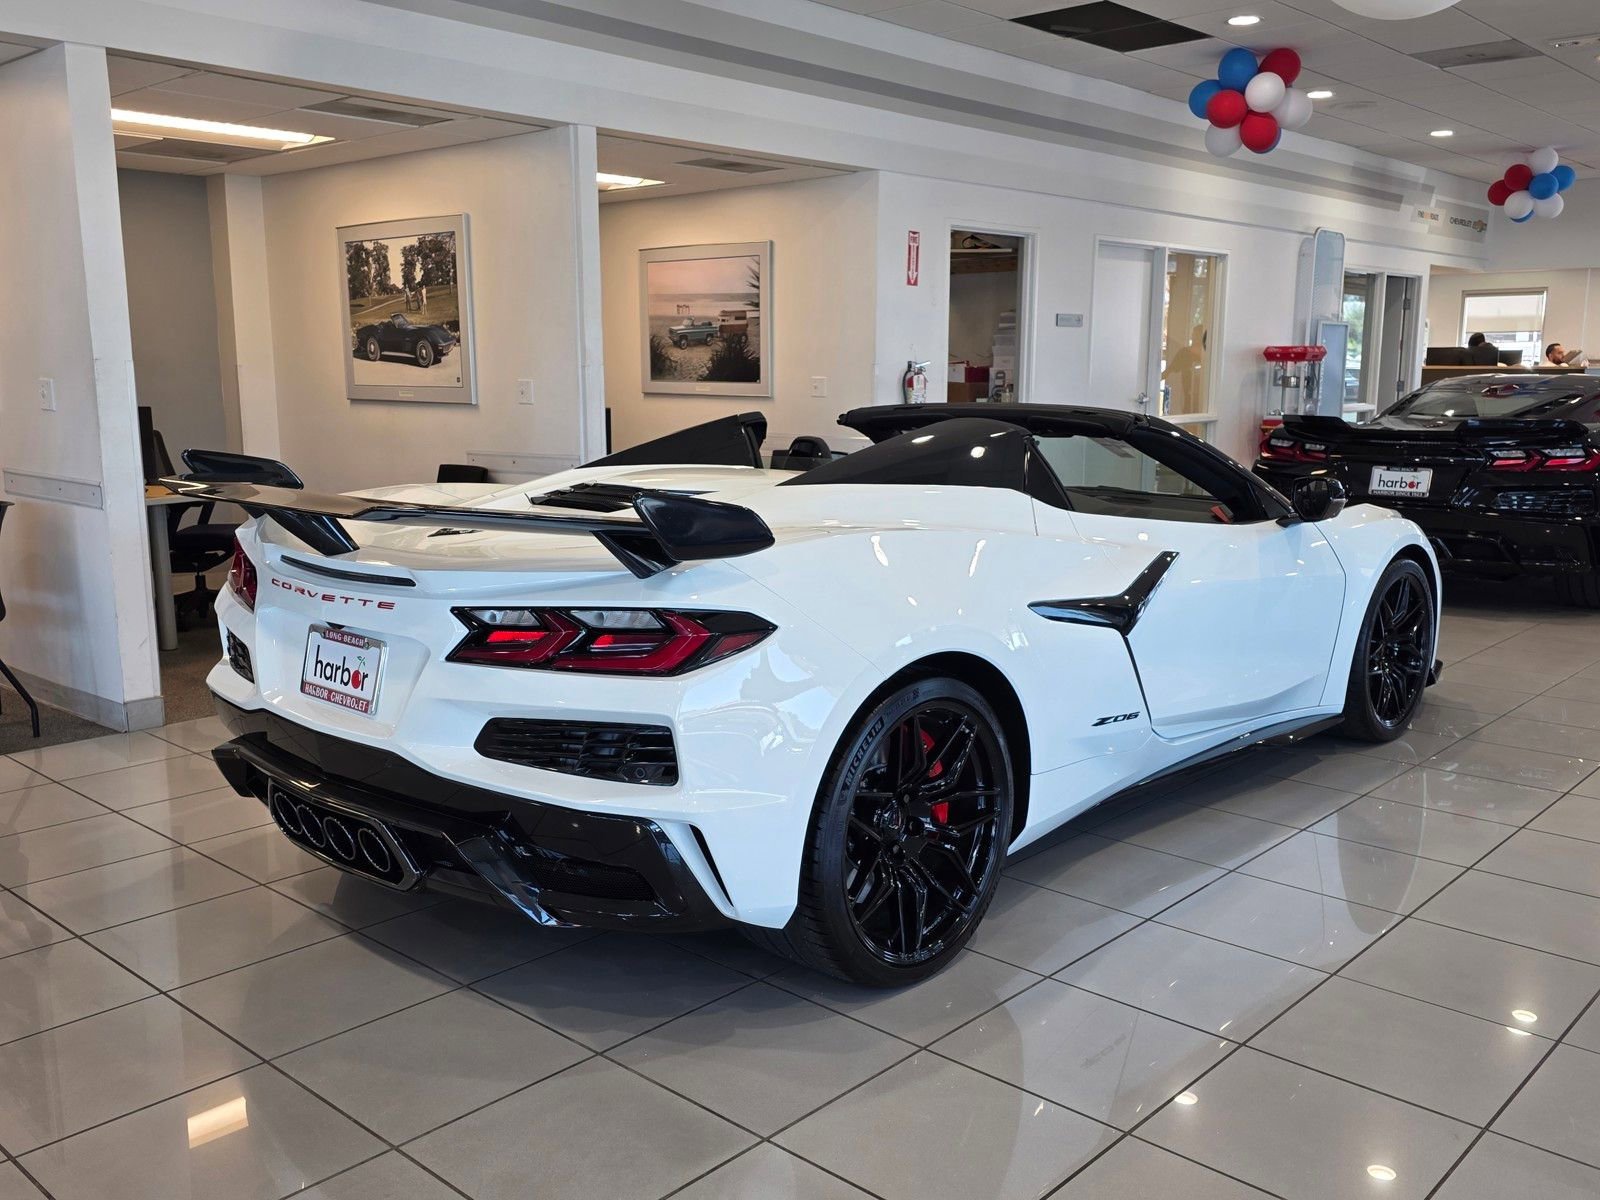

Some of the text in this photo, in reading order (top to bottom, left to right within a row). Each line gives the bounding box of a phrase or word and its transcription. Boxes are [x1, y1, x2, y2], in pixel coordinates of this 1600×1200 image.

[1378, 473, 1422, 490] harbor
[271, 577, 396, 610] CORVETTE
[325, 630, 364, 647] LONG BEACH
[314, 644, 369, 691] harbor
[1091, 711, 1141, 727] Z06
[844, 719, 884, 787] MICHELIN
